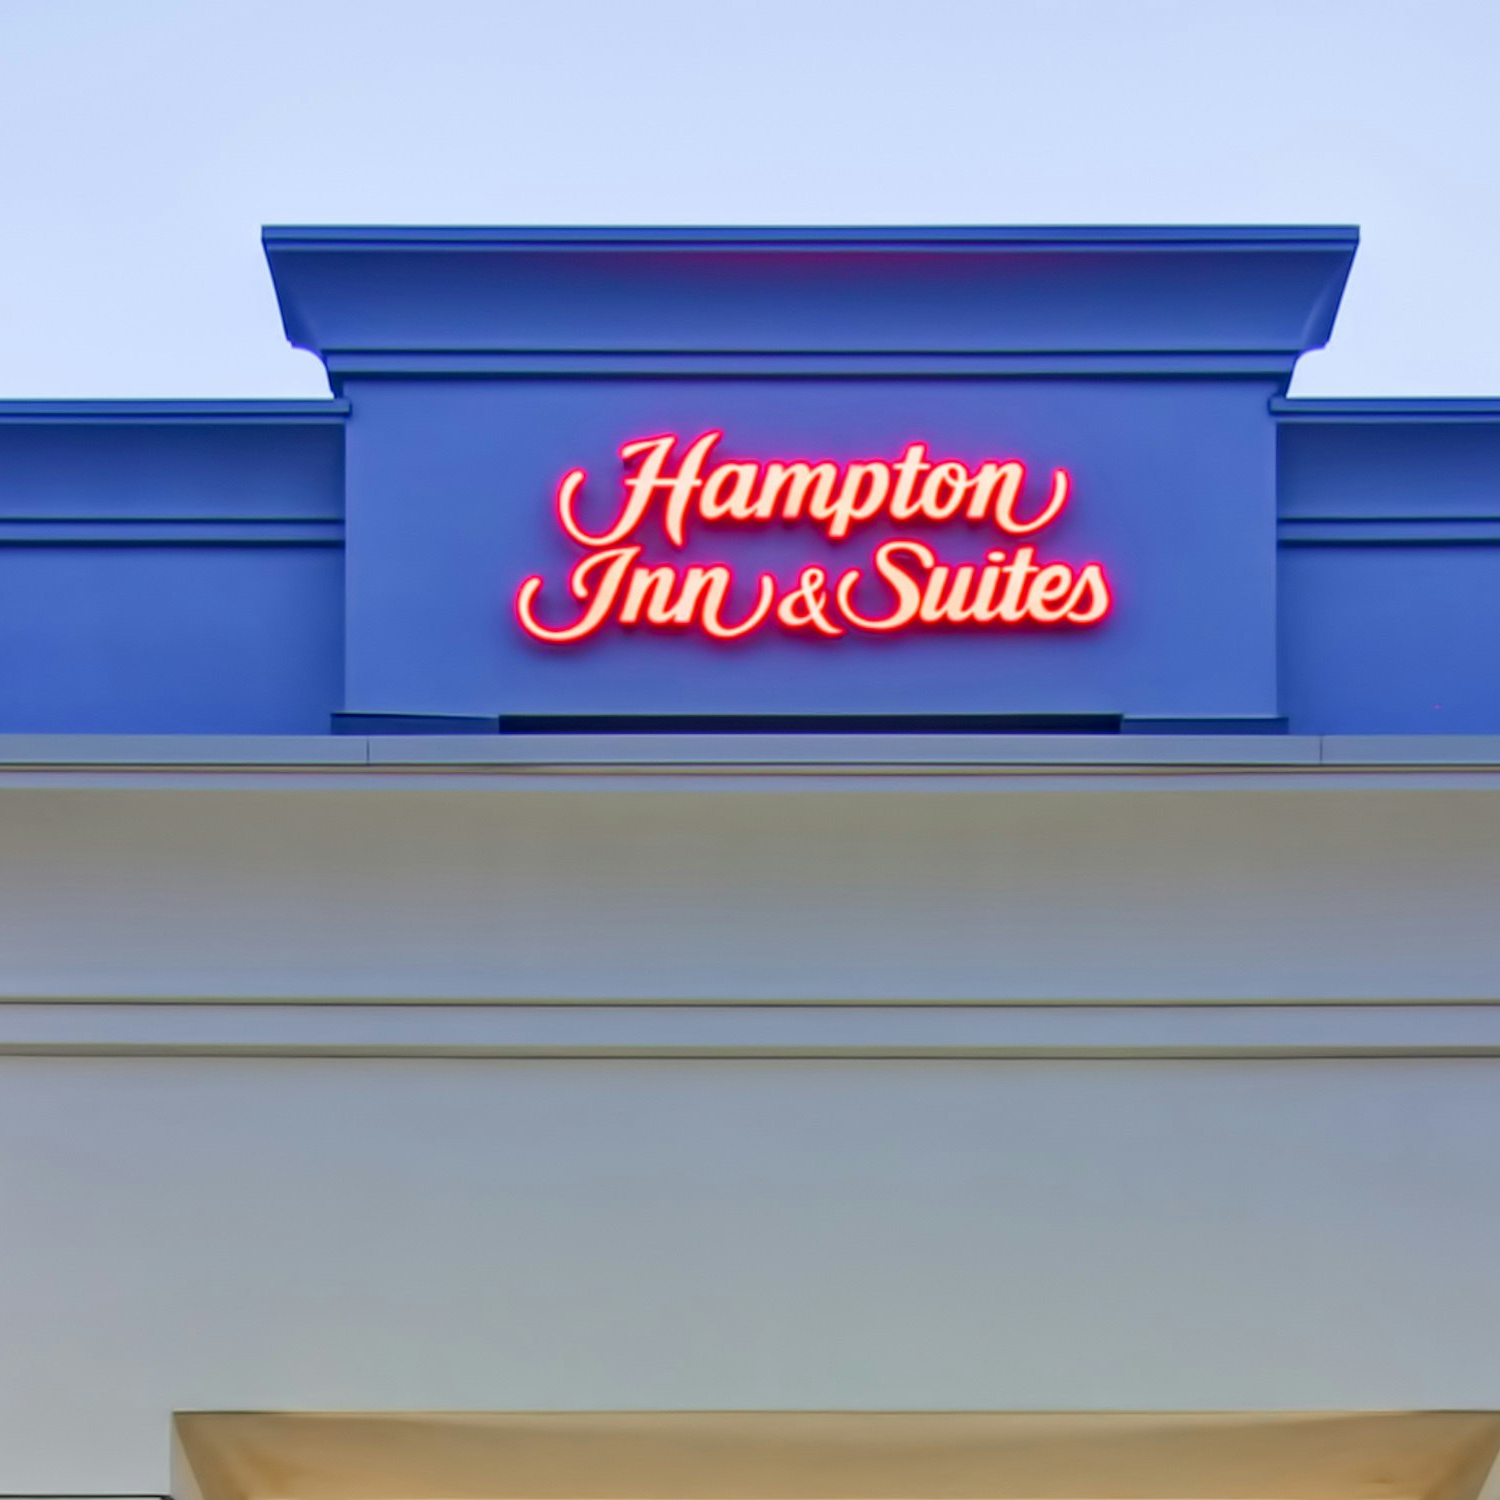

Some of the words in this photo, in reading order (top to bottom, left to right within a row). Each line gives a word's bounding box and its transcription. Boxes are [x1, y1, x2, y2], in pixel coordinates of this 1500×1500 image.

[557, 429, 1071, 548] Hampton
[515, 543, 775, 643] Inn
[775, 566, 846, 636] &
[835, 539, 1113, 633] Suites
